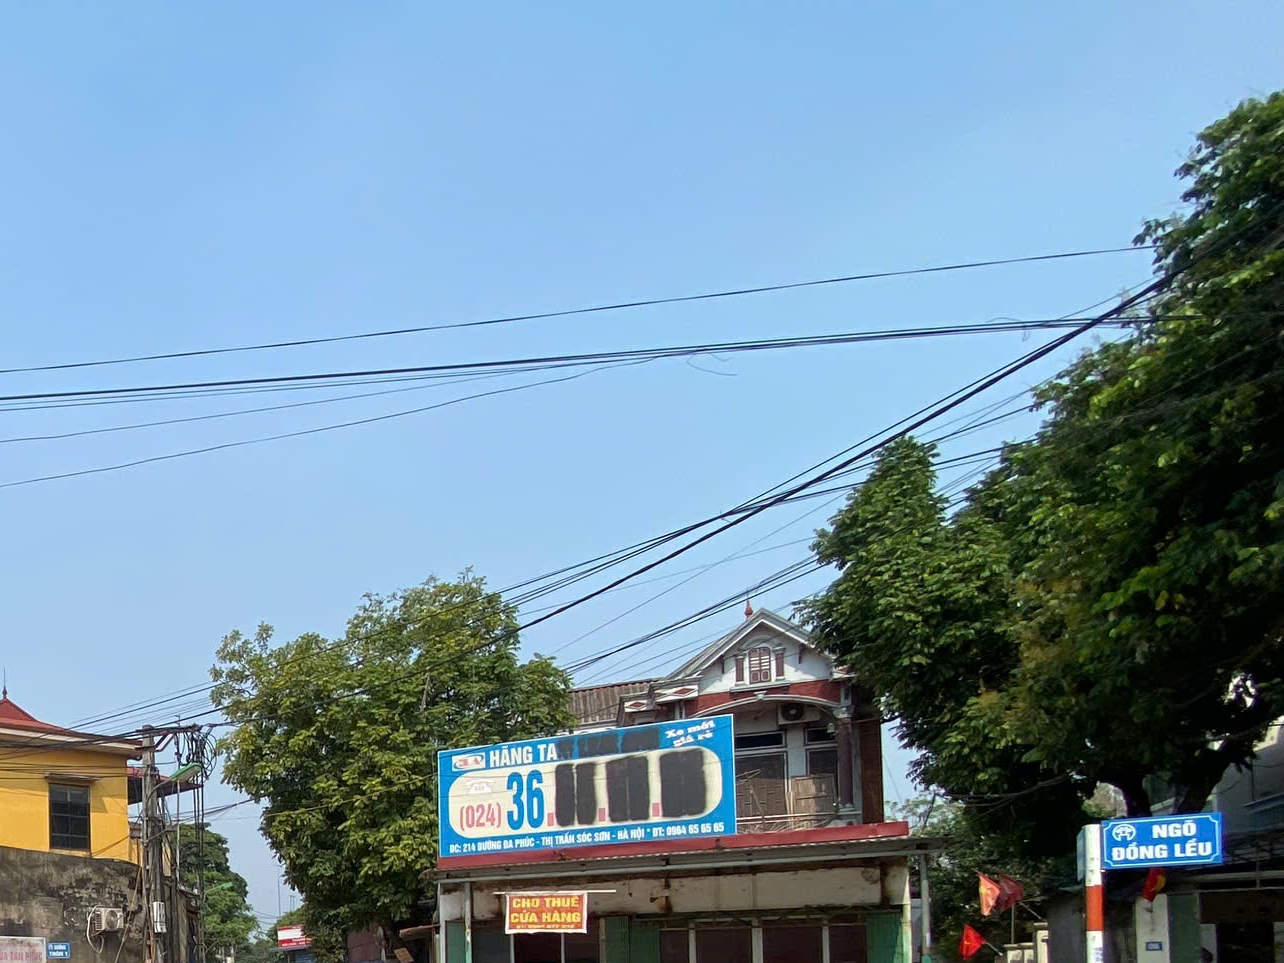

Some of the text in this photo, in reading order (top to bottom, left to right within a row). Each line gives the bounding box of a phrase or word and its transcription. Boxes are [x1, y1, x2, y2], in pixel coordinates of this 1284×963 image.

[665, 729, 684, 738] Xe
[489, 745, 533, 768] HÃNG
[459, 803, 502, 831] (024)
[1151, 820, 1197, 839] NGÕ
[462, 843, 476, 853] 214
[515, 836, 535, 848] PHÚC
[541, 836, 554, 848] THỊ
[555, 832, 575, 845] TRẤN
[576, 831, 592, 843] SÓC
[594, 831, 611, 842] SƠN
[617, 828, 628, 840] HÀ
[630, 828, 645, 841] NỘI
[512, 896, 580, 908] CHO THUÊ
[510, 910, 581, 923] CỬA HÀNG
